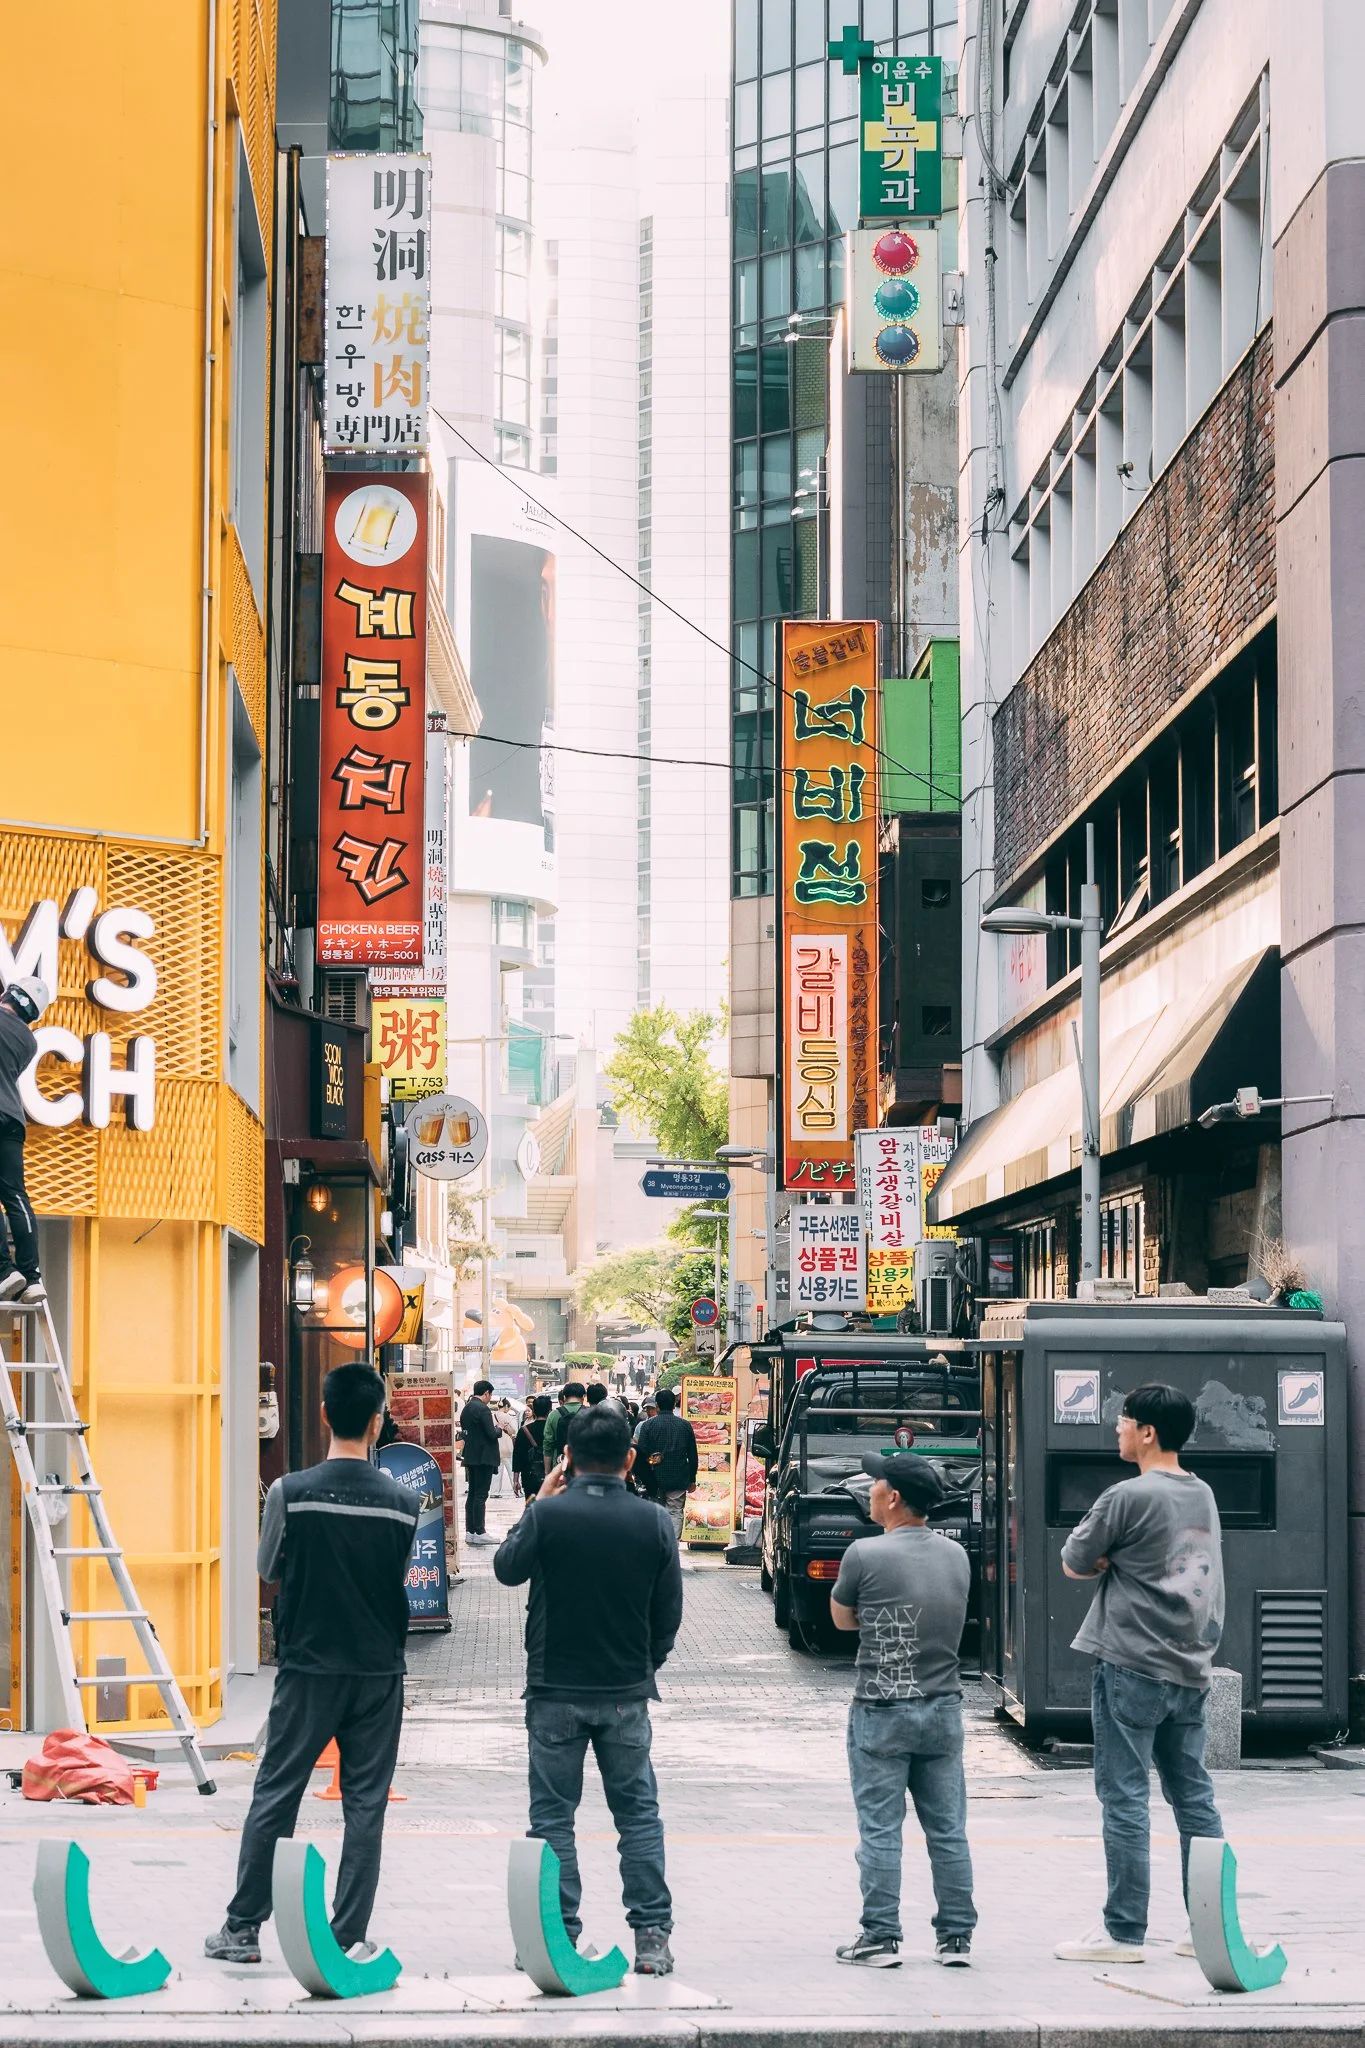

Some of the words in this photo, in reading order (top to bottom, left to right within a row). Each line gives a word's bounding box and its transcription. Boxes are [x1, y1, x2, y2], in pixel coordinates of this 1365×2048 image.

[872, 61, 932, 80] 이윤수
[880, 82, 920, 211] 비뇨기과
[875, 255, 900, 273] BILLIARD
[902, 256, 916, 271] CLUB
[877, 301, 902, 319] BILLIARD
[903, 302, 917, 317] CLUB
[336, 304, 366, 408] 한우방
[877, 346, 901, 364] BILLIARD
[903, 348, 917, 363] CLUB
[331, 577, 417, 906] 계동치킨
[793, 685, 867, 905] 너비집
[324, 938, 360, 948] チキン
[366, 940, 372, 948] &
[378, 937, 415, 949] ホープ
[322, 950, 353, 960] 명동점
[367, 951, 419, 960] 775-5001
[379, 1009, 440, 1071] 粥
[796, 947, 841, 1129] 갈비등심
[325, 1043, 341, 1065] SOON
[328, 1064, 344, 1086] WOO
[409, 1077, 443, 1088] T.753
[326, 1084, 344, 1106] BLACK
[449, 1152, 474, 1163] 카스
[673, 1172, 700, 1183] 명동3길
[902, 1142, 917, 1206] 자갈구이
[660, 1183, 698, 1192] Myeongdong
[699, 1184, 713, 1192] 3-gil
[876, 1138, 905, 1247] 암소생갈비살
[799, 1216, 859, 1242] 구두수선전문
[798, 1247, 857, 1271] 상품권
[869, 1251, 912, 1267] 상품
[798, 1276, 858, 1301] 신용카드
[869, 1284, 912, 1299] 구두수
